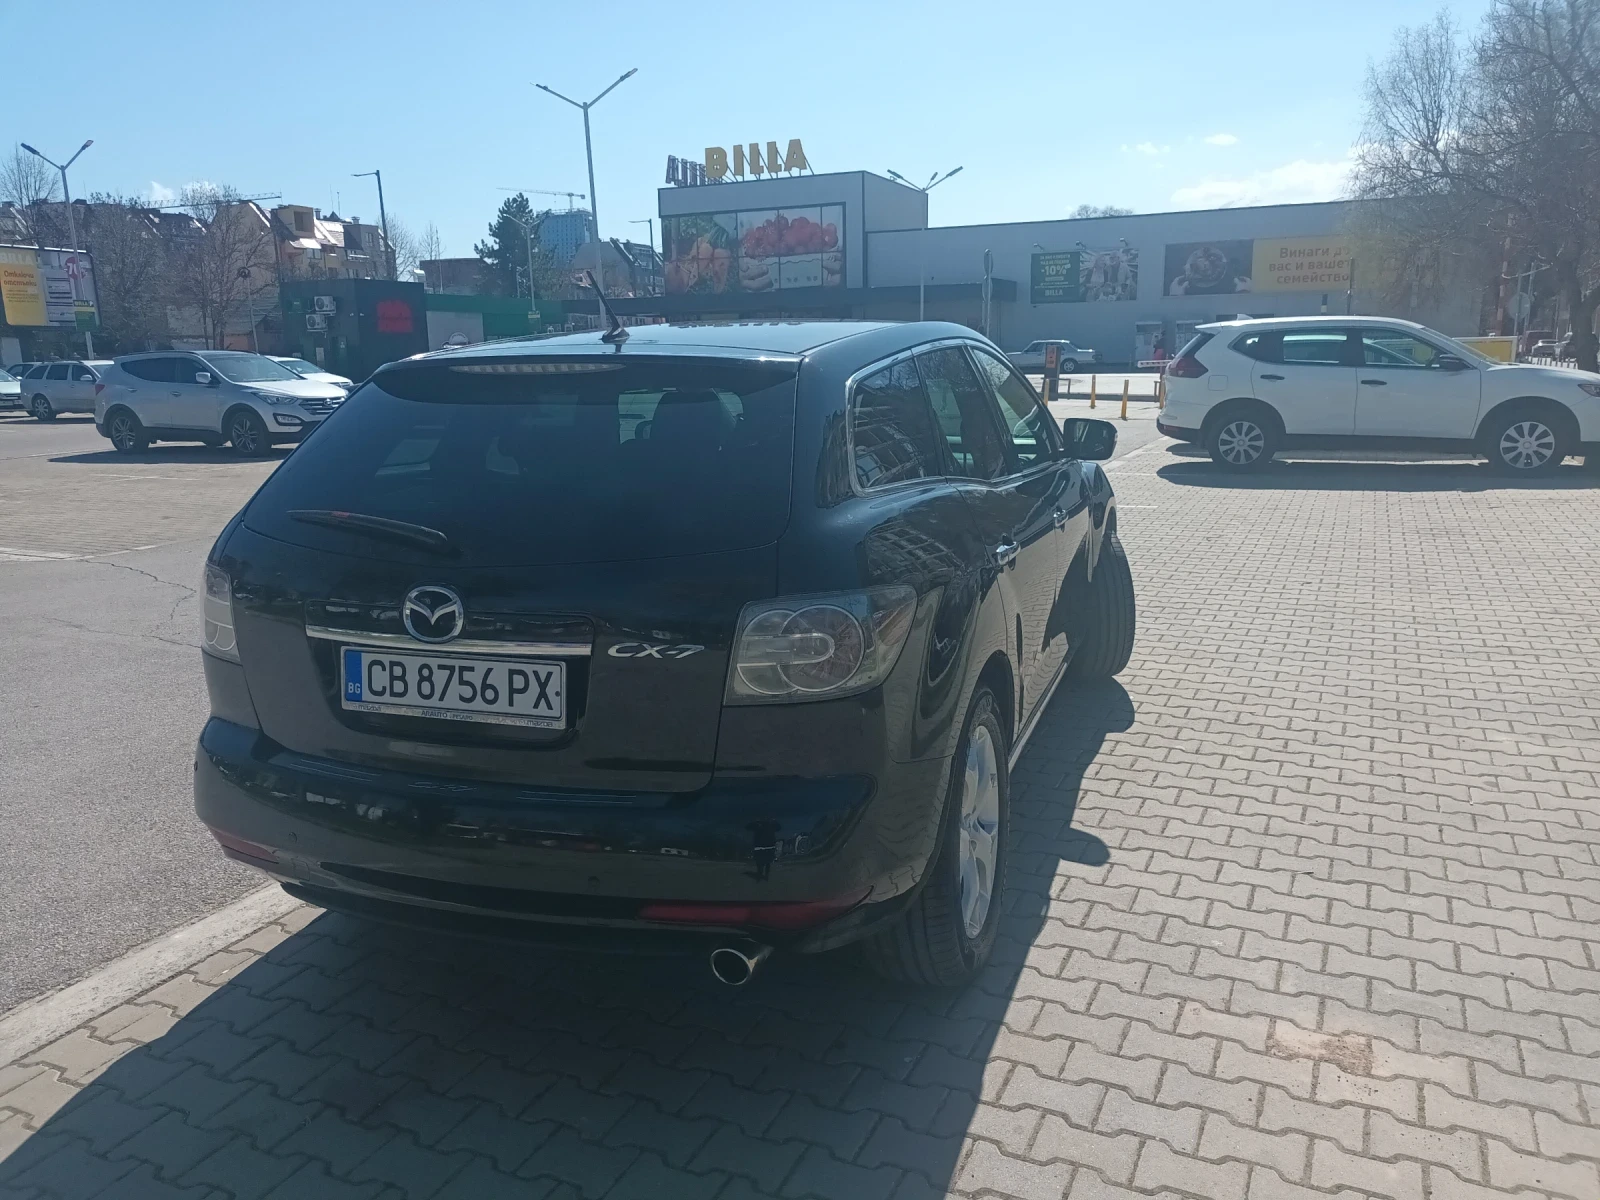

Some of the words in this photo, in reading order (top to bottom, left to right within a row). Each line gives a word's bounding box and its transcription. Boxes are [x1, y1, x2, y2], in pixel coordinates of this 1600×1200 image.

[704, 139, 808, 179] BILLA
[1279, 247, 1330, 258] Винаги
[1268, 262, 1293, 272] вас
[1295, 262, 1304, 271] и
[1276, 271, 1350, 284] семейство
[1044, 289, 1064, 297] BILLA
[607, 642, 705, 659] CX-7
[347, 682, 361, 694] BG
[367, 659, 409, 698] CB
[416, 663, 500, 706] 8756
[507, 668, 554, 711] PX
[421, 710, 448, 718] ARAUTO
